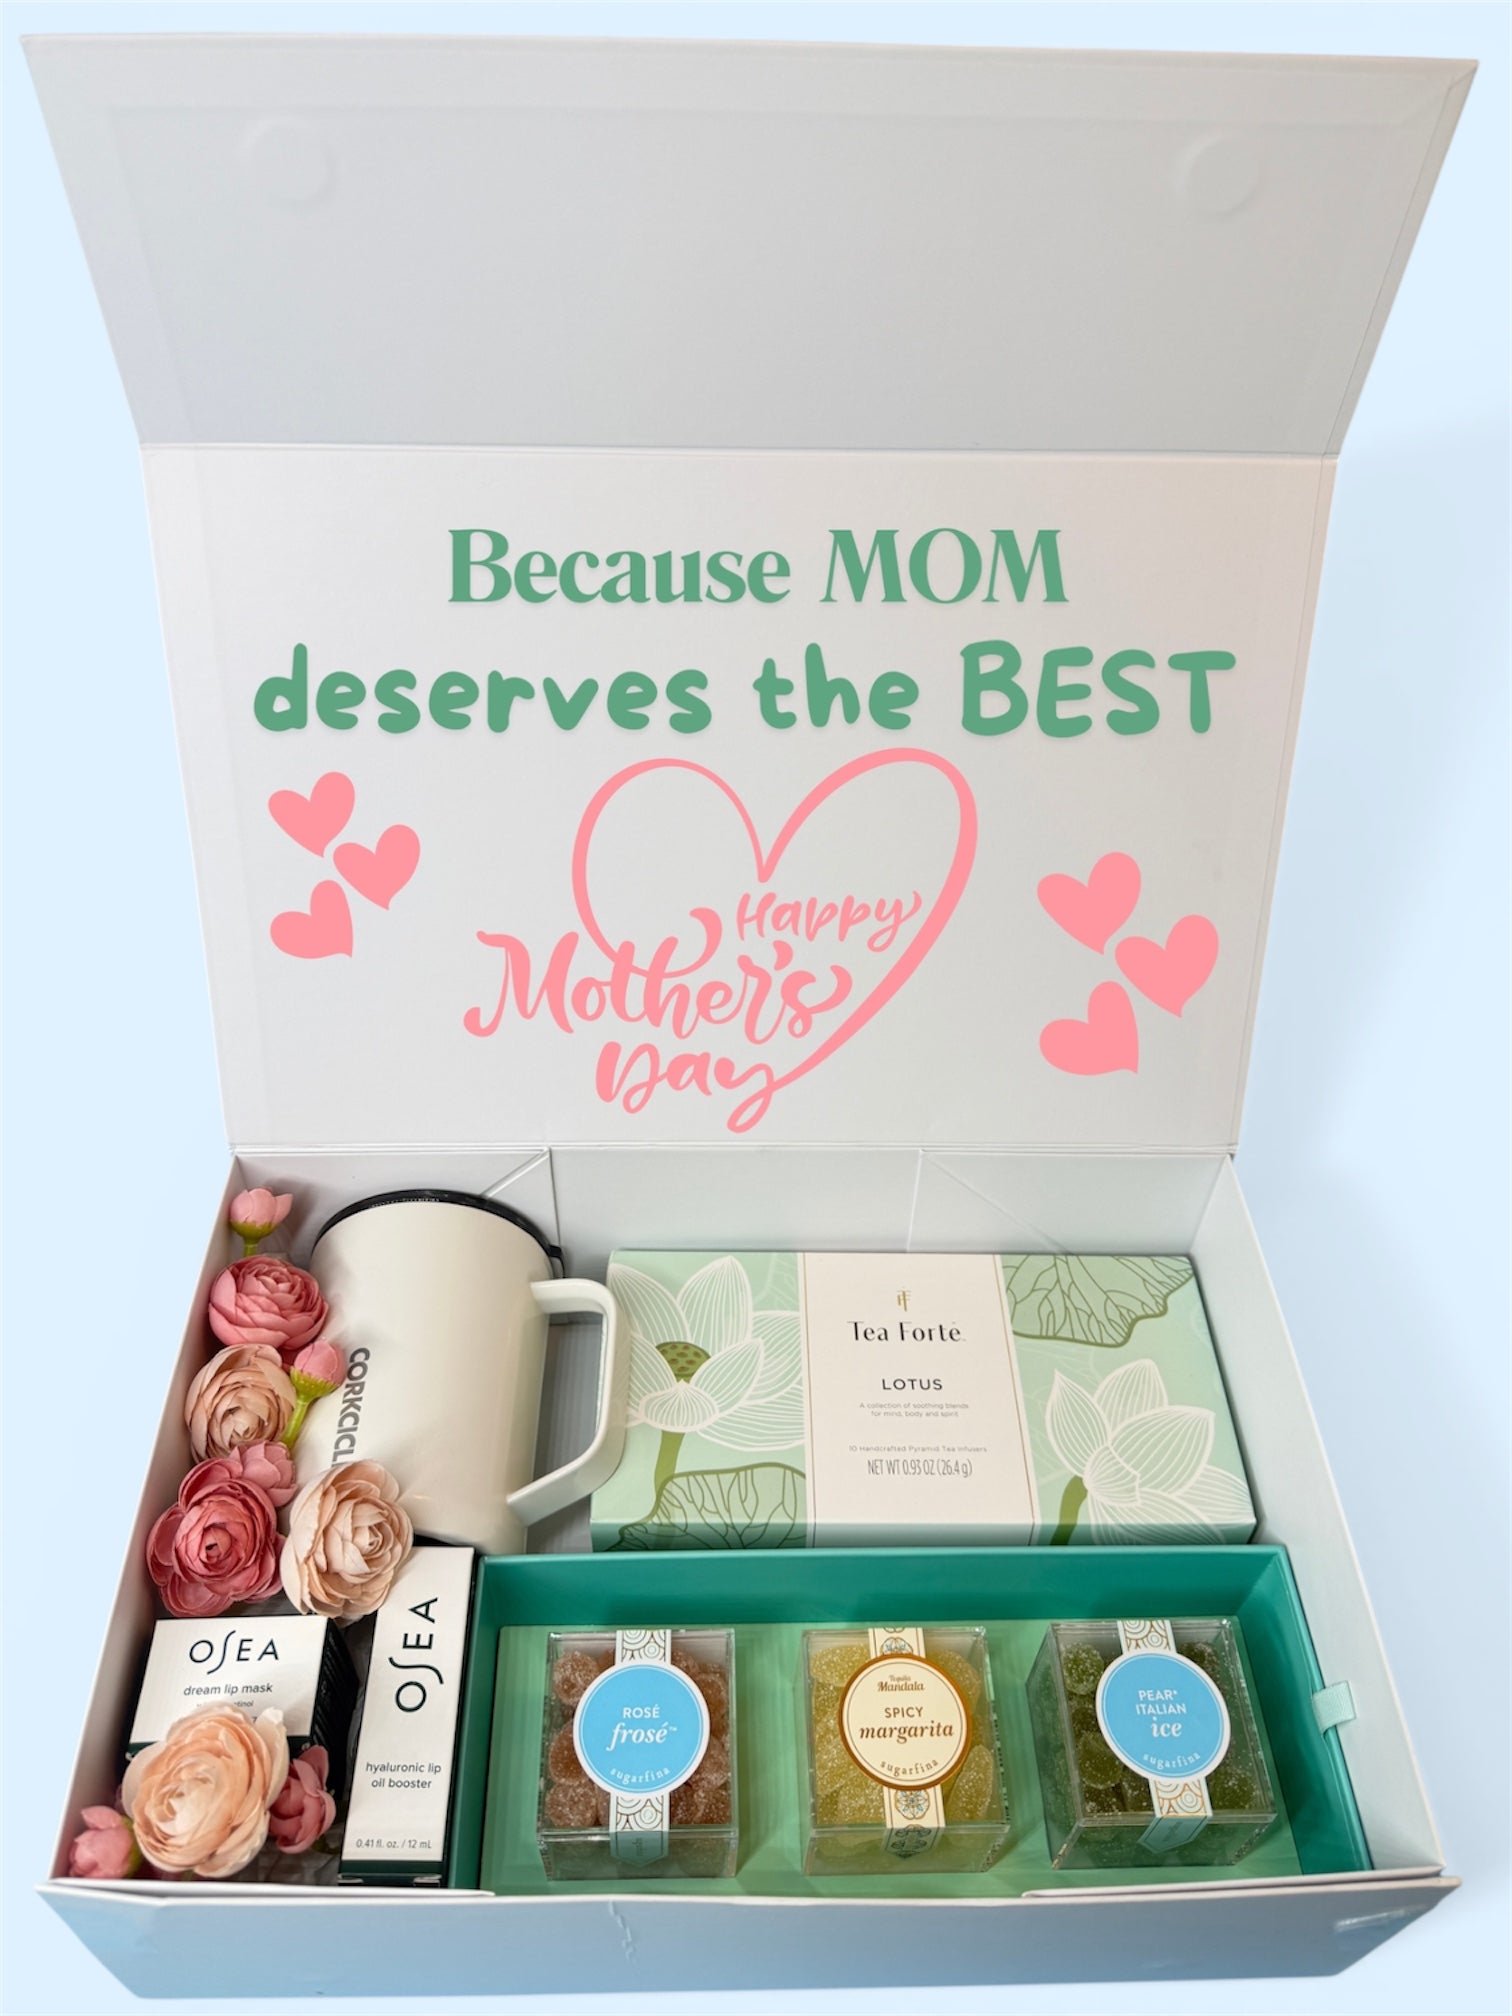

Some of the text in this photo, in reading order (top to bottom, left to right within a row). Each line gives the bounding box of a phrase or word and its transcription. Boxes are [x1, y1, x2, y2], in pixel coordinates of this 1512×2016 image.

[847, 1320, 888, 1341] Tea
[881, 1378, 943, 1391] LOTUS
[913, 1402, 944, 1410] soothing
[905, 1410, 923, 1418] body
[941, 1410, 959, 1418] spirit
[908, 1445, 940, 1453] Pyramid
[867, 1459, 973, 1478] NET WT 0.93 OZ (26.4 g)
[189, 1630, 280, 1675] OSEA
[388, 1597, 444, 1712] OSEA
[183, 1683, 273, 1696] dream lip mask
[877, 1681, 925, 1692] Mandala
[623, 1704, 660, 1718] ROSÉ
[884, 1706, 923, 1718] SPICY
[1135, 1704, 1187, 1714] ITALIAN
[859, 1720, 953, 1743] margarita
[1150, 1717, 1182, 1737] ice
[1142, 1752, 1200, 1769] sugarfina
[366, 1762, 442, 1775] hyaluronic lip
[880, 1759, 939, 1777] sugarfina
[610, 1767, 670, 1784] sugarfina
[371, 1778, 432, 1789] oil booster
[356, 1839, 374, 1848] 0.41
[376, 1839, 384, 1848] fl.
[408, 1840, 417, 1849] 12
[420, 1840, 432, 1849] mL
